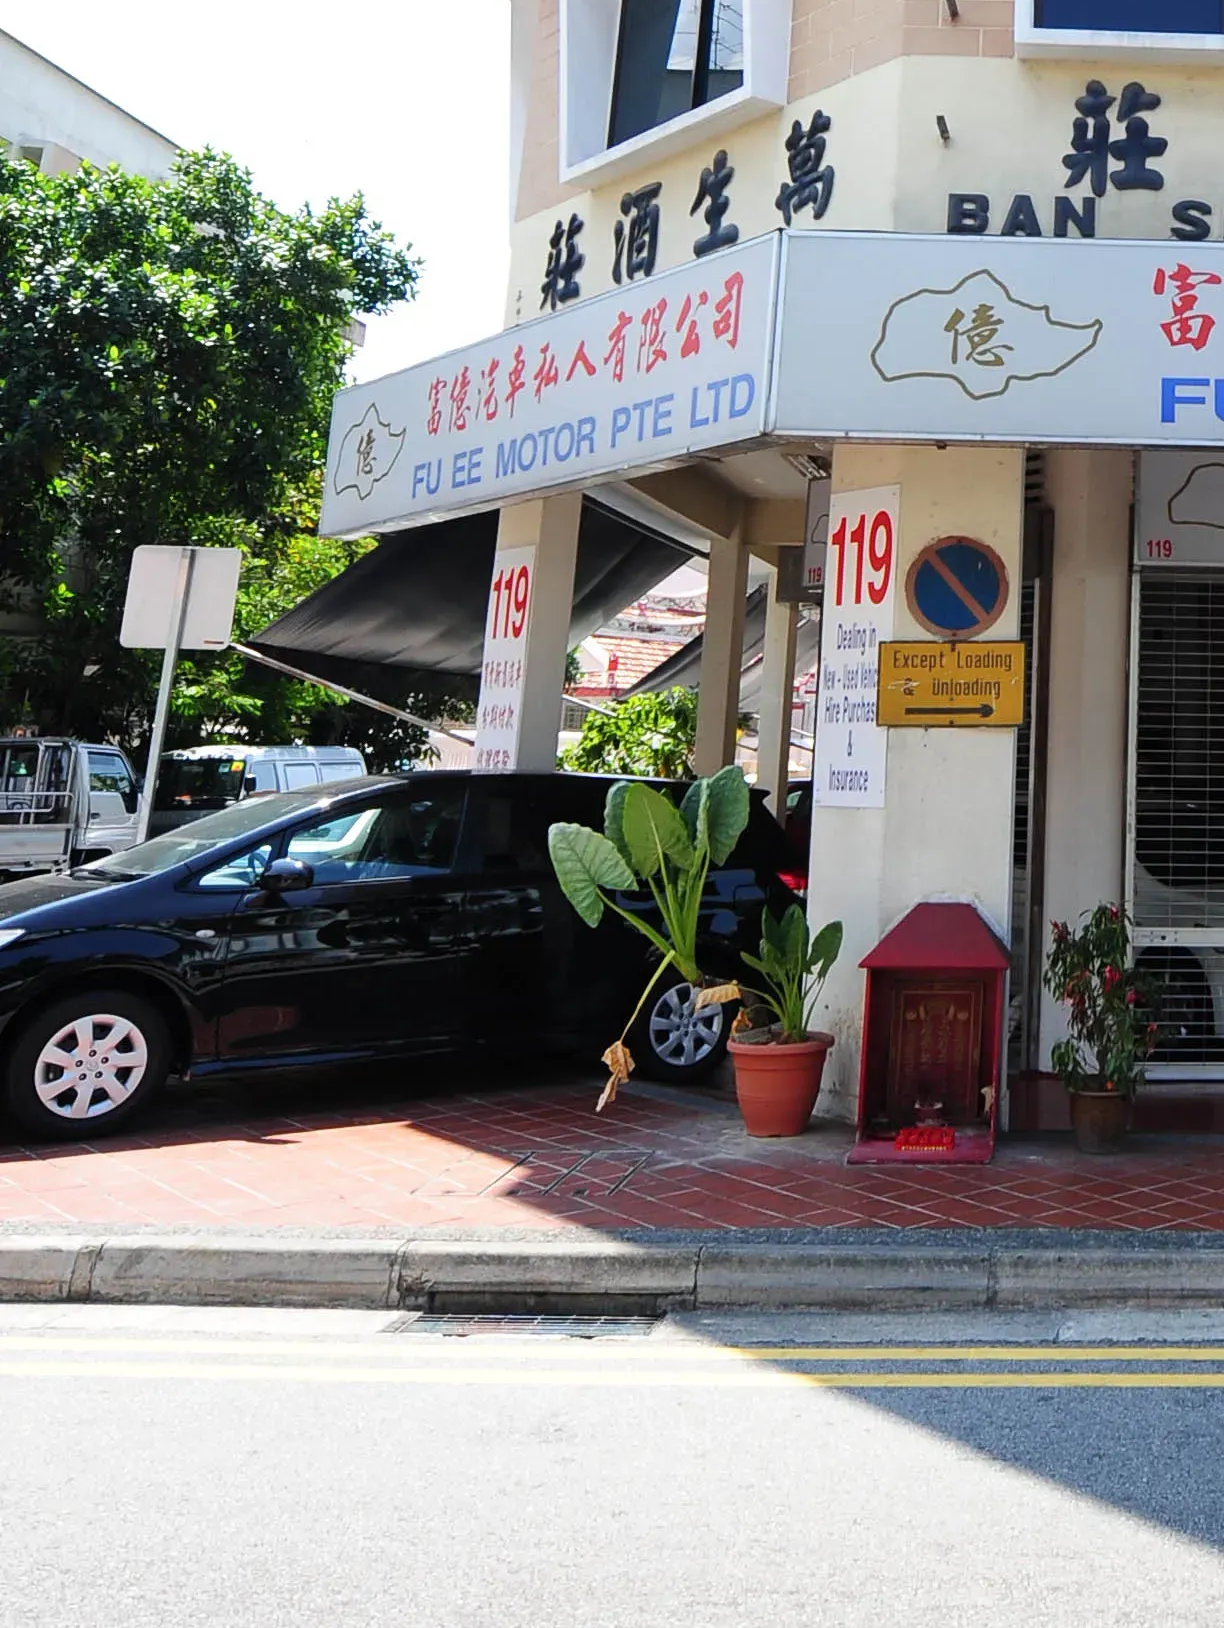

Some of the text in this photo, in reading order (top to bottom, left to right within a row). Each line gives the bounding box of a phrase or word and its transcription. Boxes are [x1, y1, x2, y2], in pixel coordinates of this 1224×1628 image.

[948, 193, 1096, 239] BAN
[944, 303, 1014, 367] 億
[426, 271, 743, 437] 富億汽車私人有限公司
[411, 371, 758, 499] FU EE MOTOR PTE LTD
[830, 509, 894, 607] 119
[1146, 539, 1173, 559] 119
[808, 566, 823, 584] 119
[492, 564, 530, 640] 119
[836, 622, 867, 657] Dealing
[893, 650, 1013, 673] Except Loading
[932, 677, 1001, 700] Unloading
[824, 695, 875, 724] Hire Purchas
[829, 762, 869, 793] Insurance
